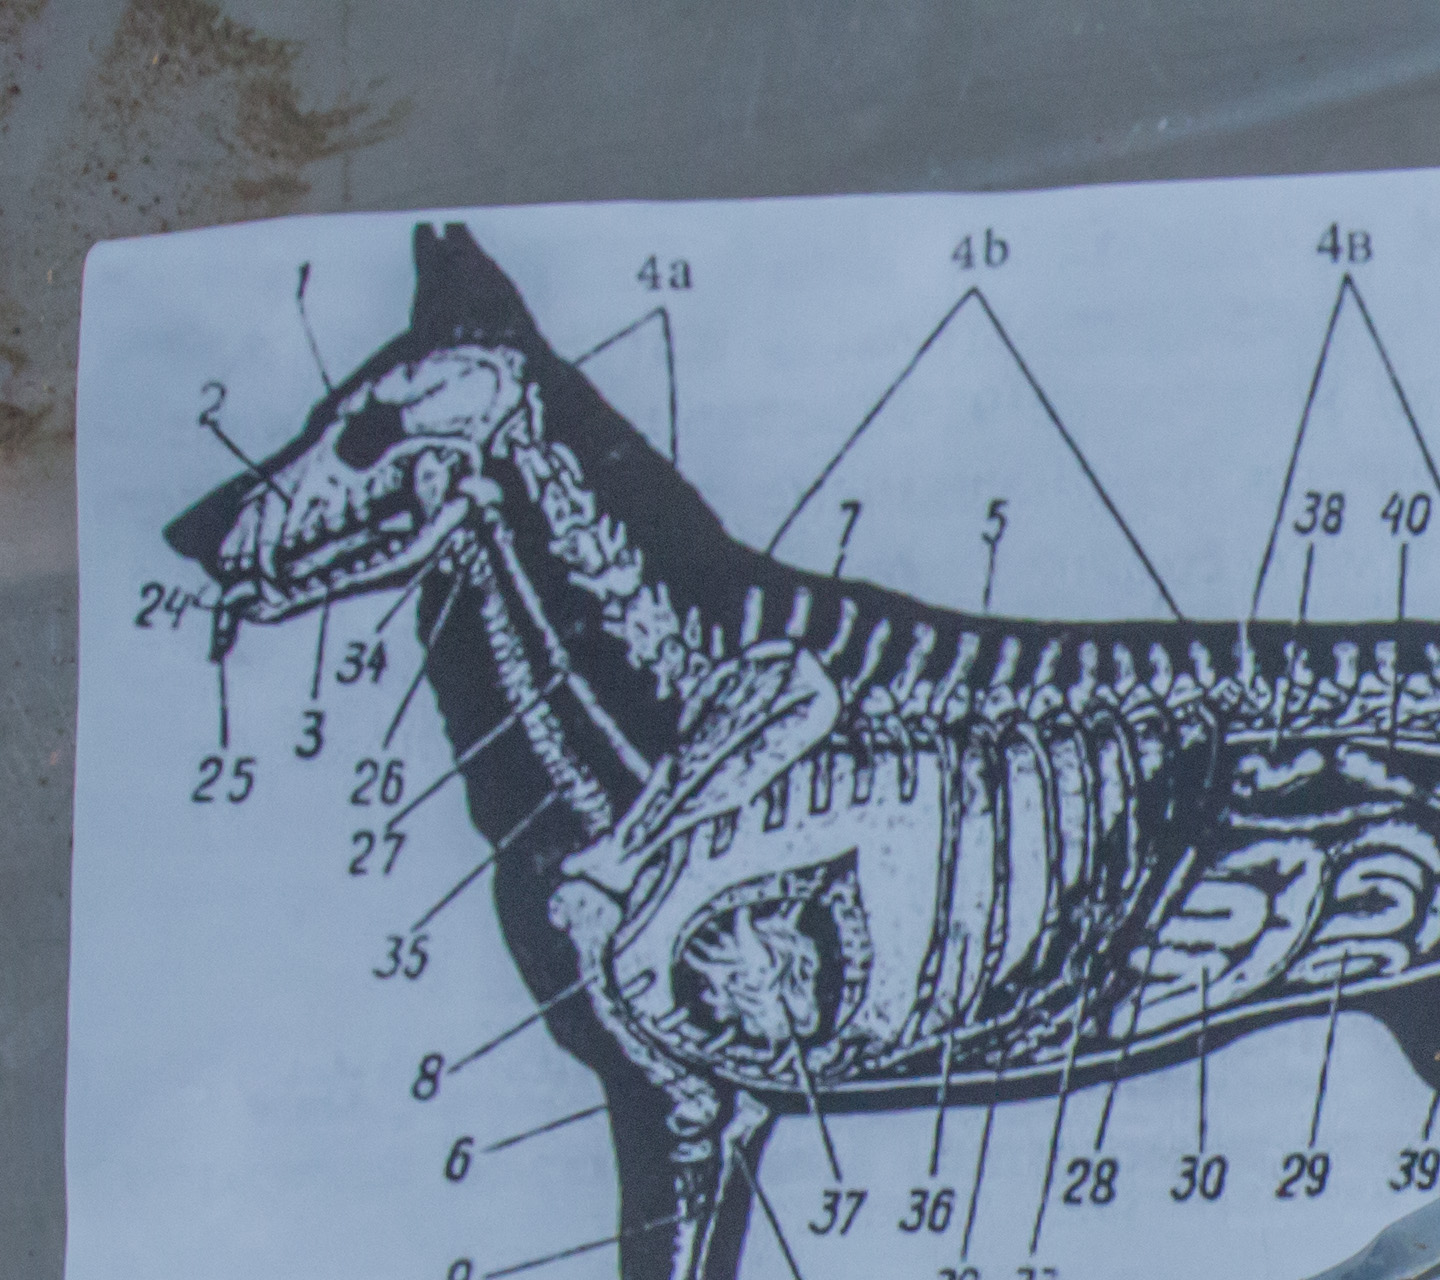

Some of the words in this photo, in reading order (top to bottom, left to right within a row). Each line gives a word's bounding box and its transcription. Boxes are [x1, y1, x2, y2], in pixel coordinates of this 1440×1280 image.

[199, 379, 226, 424] 2
[839, 499, 864, 548] 7
[981, 499, 1008, 549] 5
[1293, 490, 1346, 537] 38
[1380, 491, 1433, 537] 40
[134, 581, 182, 630] 24
[334, 641, 386, 684] 34
[294, 709, 326, 761] 3
[191, 754, 257, 805] 25
[349, 757, 405, 807] 26
[349, 829, 404, 876] 27
[372, 933, 430, 982] 35
[410, 1052, 446, 1103] 8
[443, 1135, 475, 1184] 6
[1061, 1157, 1120, 1207] 28
[1170, 1156, 1229, 1203] 30
[1275, 1152, 1332, 1201] 29
[808, 1188, 869, 1237] 37
[898, 1187, 957, 1235] 36
